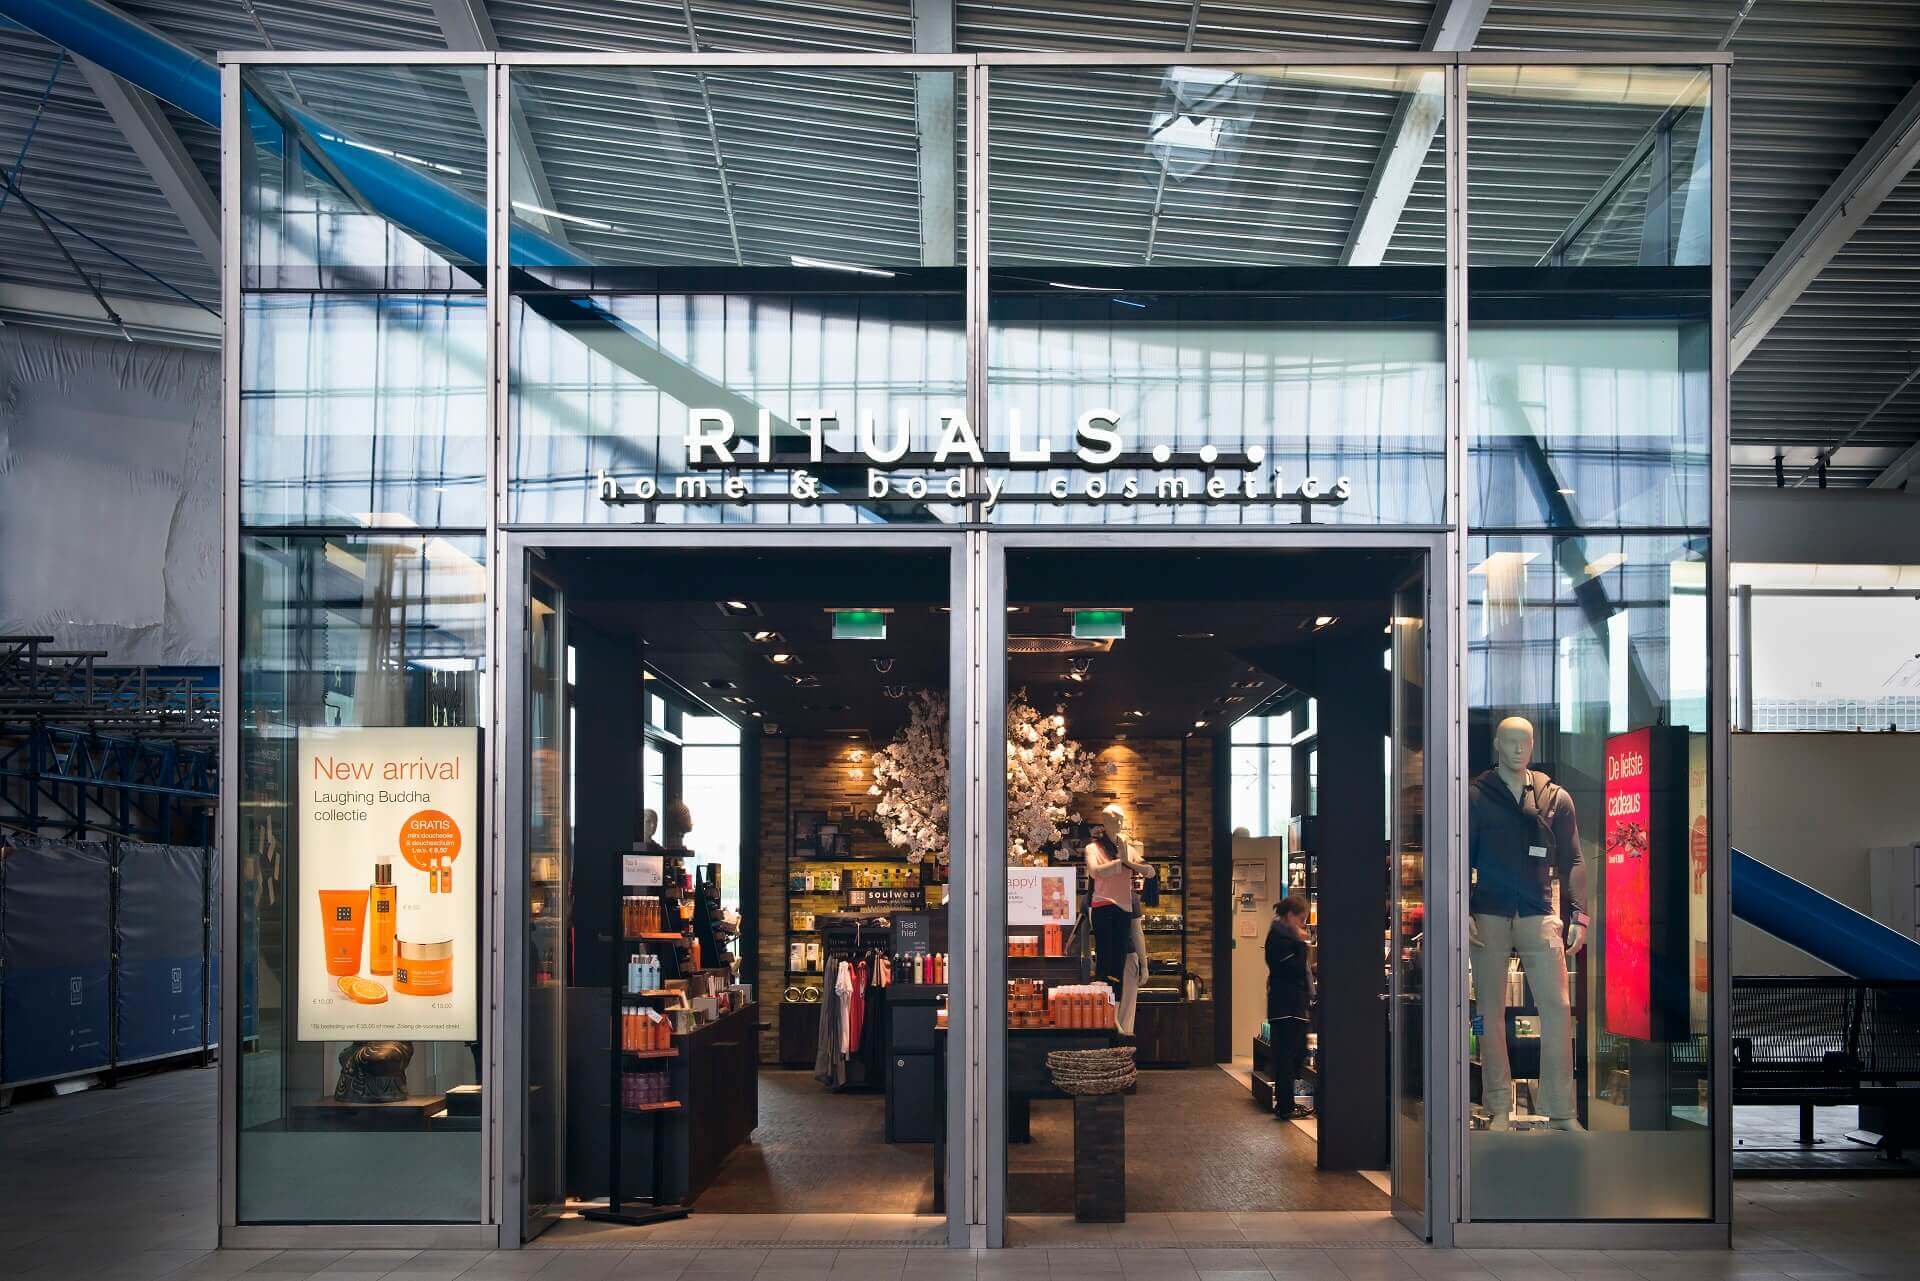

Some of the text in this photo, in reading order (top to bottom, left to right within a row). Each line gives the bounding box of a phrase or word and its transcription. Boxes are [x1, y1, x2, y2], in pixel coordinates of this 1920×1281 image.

[597, 465, 1350, 506] home & body cosmetics
[314, 756, 460, 780] New arrival
[1608, 751, 1643, 780] De liefste
[314, 790, 430, 805] Laughing Buddha
[1608, 790, 1641, 816] cadeaus
[314, 809, 367, 821] collectie
[411, 820, 450, 830] GRATIS
[1008, 875, 1037, 889] appy!
[868, 890, 921, 899] soulwear
[900, 920, 917, 929] Test
[901, 929, 917, 937] hier
